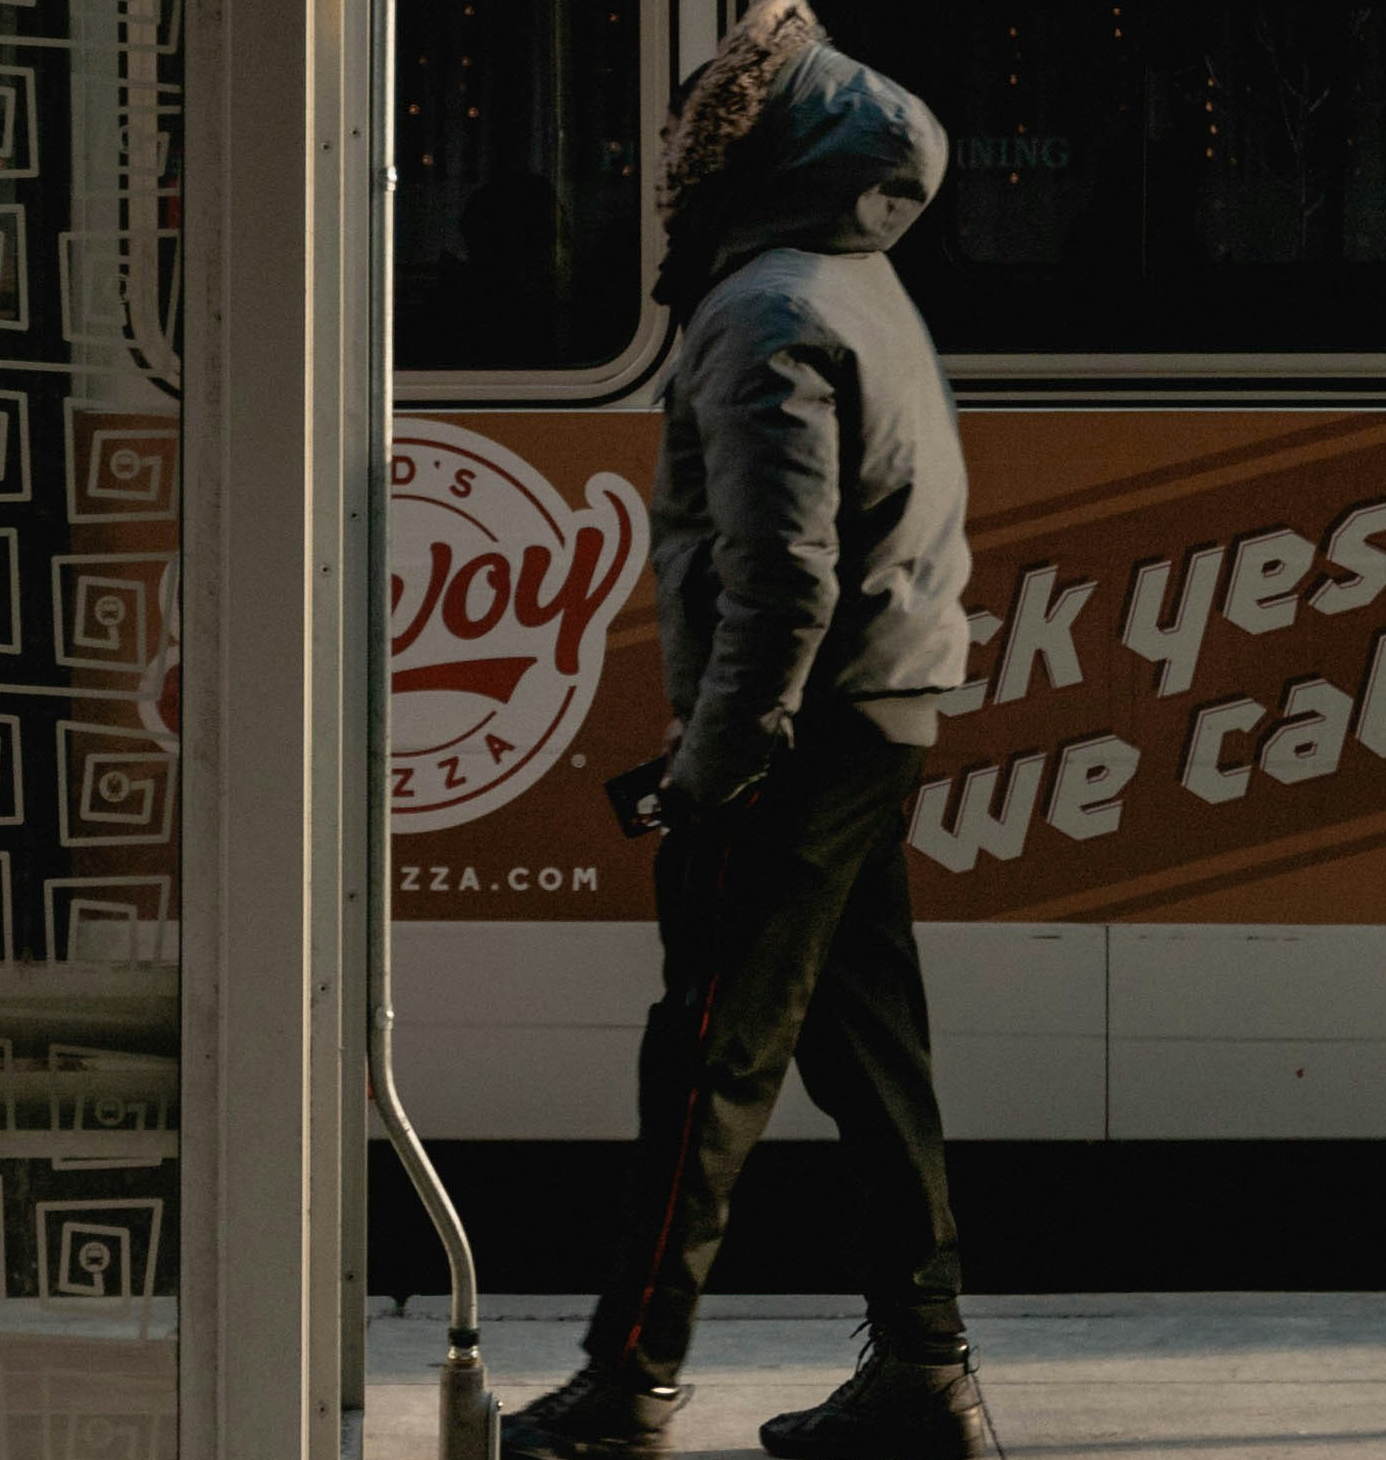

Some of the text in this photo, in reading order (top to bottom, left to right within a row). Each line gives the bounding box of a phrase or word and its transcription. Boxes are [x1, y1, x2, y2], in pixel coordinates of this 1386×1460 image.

[392, 733, 516, 798] ZZA
[907, 733, 1141, 874] we
[399, 865, 598, 892] ZZA.COM
